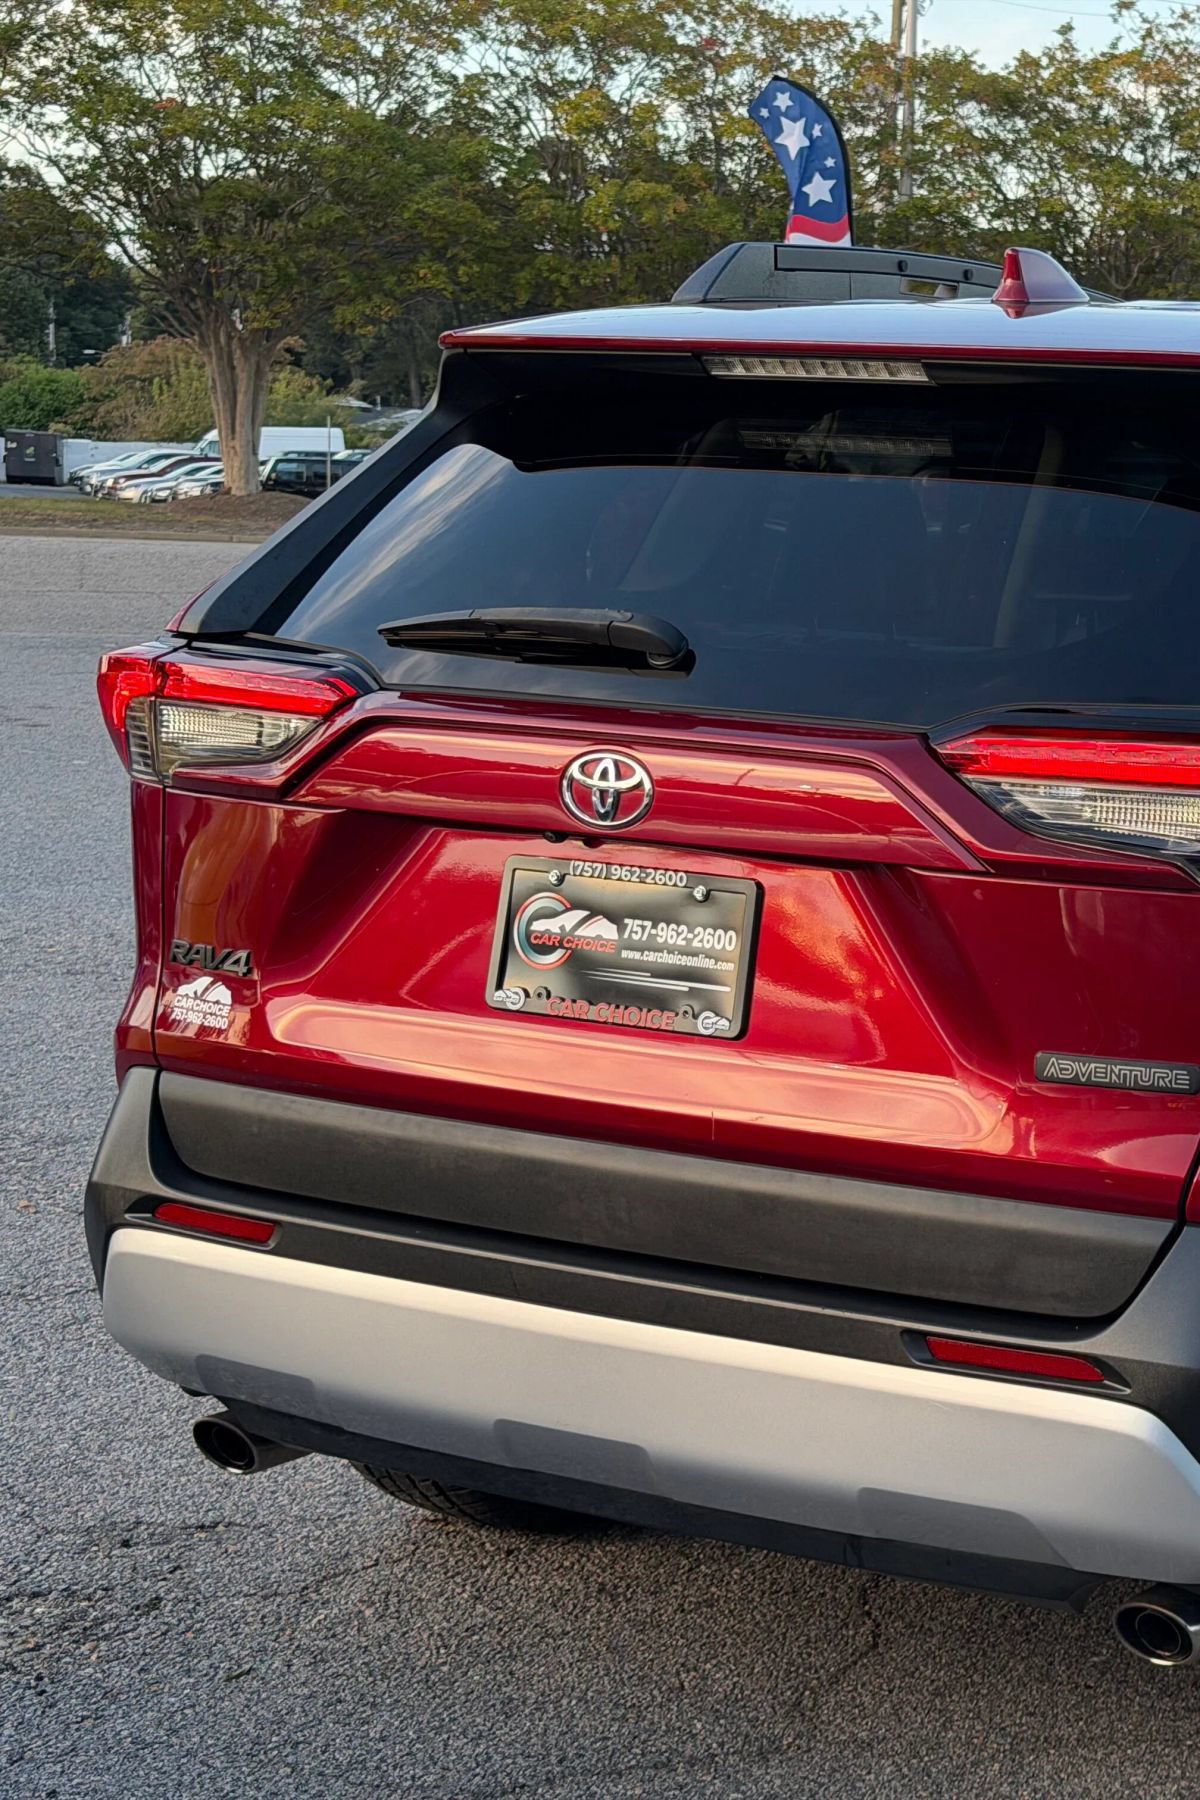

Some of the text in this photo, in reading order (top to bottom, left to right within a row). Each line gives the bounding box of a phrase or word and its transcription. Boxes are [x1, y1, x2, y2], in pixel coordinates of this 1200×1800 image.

[569, 860, 687, 887] (757) 962-2600
[530, 932, 617, 953] CAR CHOICE
[623, 918, 737, 951] 757-962-2600
[170, 939, 252, 977] RAV4
[621, 948, 735, 971] www.carchoiceonline.com
[170, 1008, 229, 1030] 757-962-2600
[546, 997, 676, 1030] CAR CHOICE
[1043, 1057, 1191, 1089] ADVENTURE
